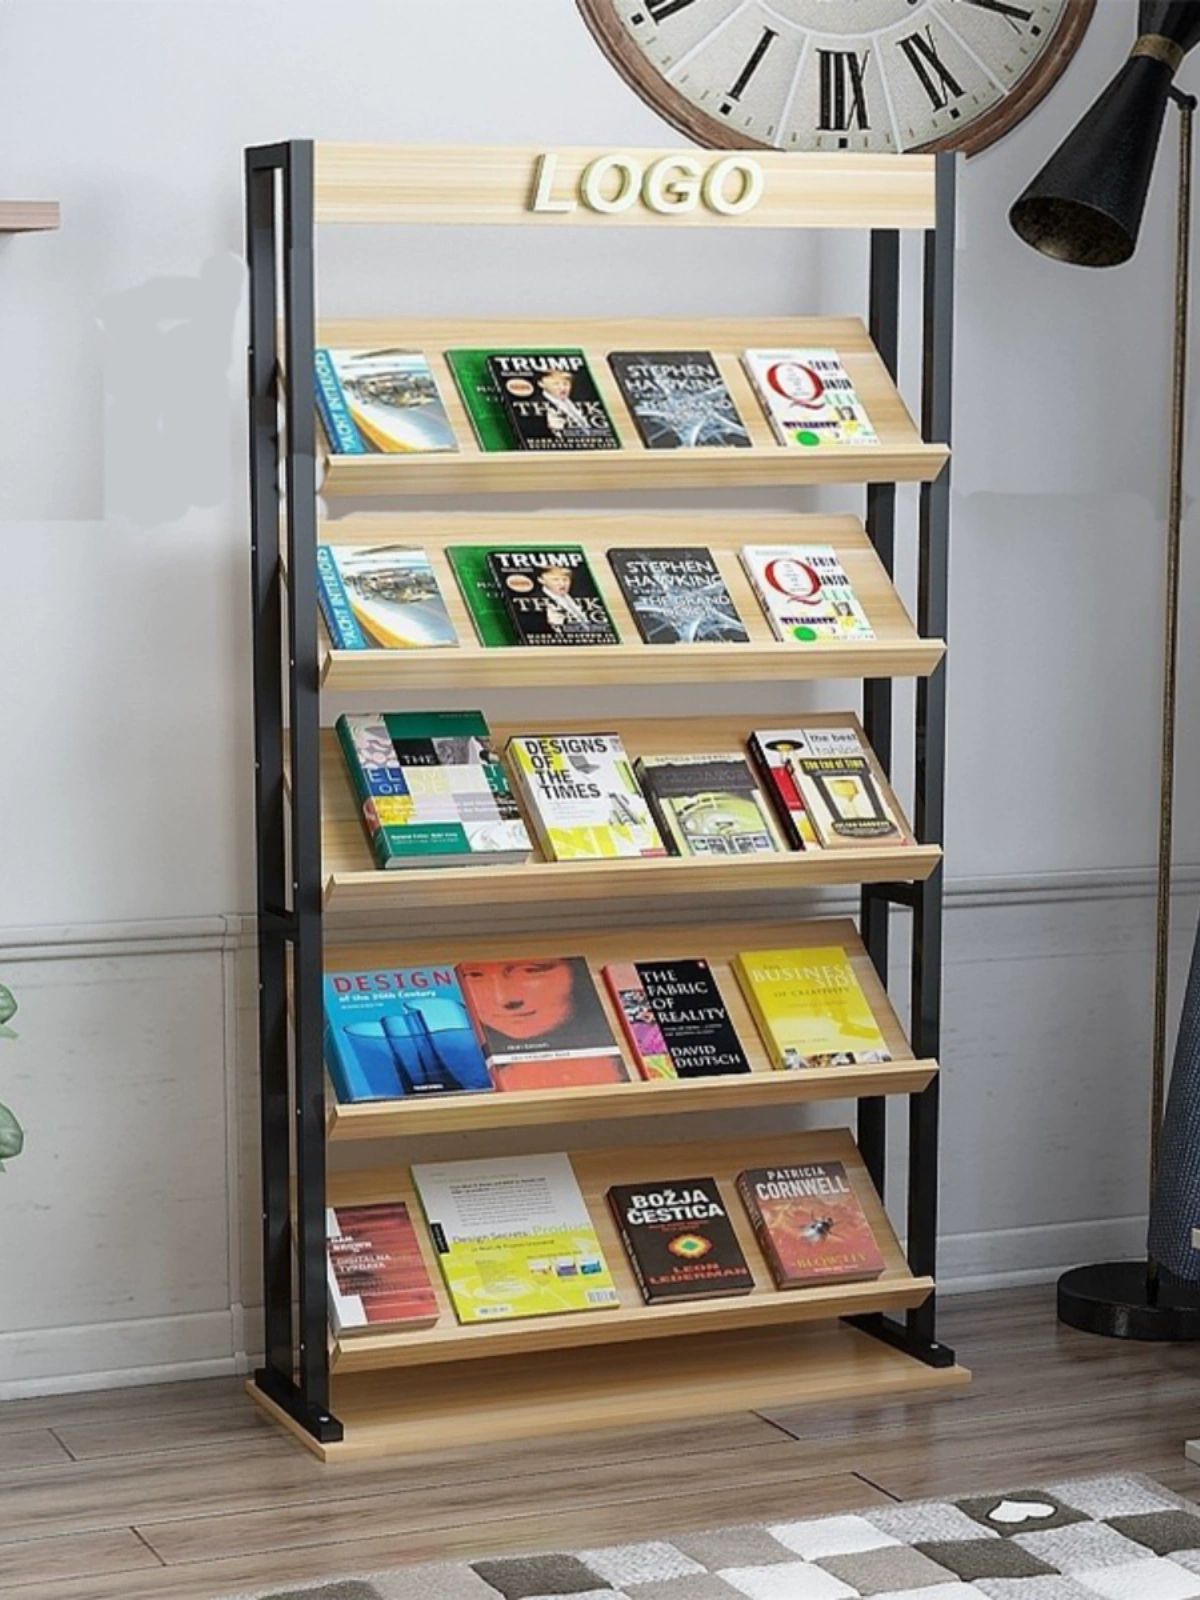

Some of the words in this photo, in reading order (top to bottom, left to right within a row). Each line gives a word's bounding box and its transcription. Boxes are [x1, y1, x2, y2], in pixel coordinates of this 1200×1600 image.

[527, 153, 764, 216] LOGO
[494, 356, 584, 372] TRUMP
[627, 363, 715, 377] STEPHEN
[624, 378, 724, 393] HAWKING
[766, 361, 826, 410] Q
[494, 553, 584, 568] TRUMP
[626, 561, 715, 573] STEPHEN
[623, 574, 723, 587] HAWKING
[764, 558, 824, 606] Q
[525, 738, 608, 755] DESIGNS
[402, 755, 436, 765] THE
[531, 755, 554, 769] OF
[535, 770, 574, 785] THE
[379, 784, 403, 794] OF
[540, 783, 601, 799] TIMES
[334, 971, 452, 993] DESIGN
[643, 969, 678, 983] THE
[647, 982, 708, 997] FABRIC
[652, 997, 674, 1010] OF
[657, 1007, 725, 1023] REALITY
[671, 1045, 716, 1057] DAVID
[767, 1166, 826, 1180] PATRICIA
[755, 1175, 850, 1201] CORNWELL
[631, 1189, 710, 1209] BOŽJA
[627, 1203, 725, 1225] ČESTICA
[452, 1234, 487, 1244] Design
[673, 1263, 719, 1273] LEON
